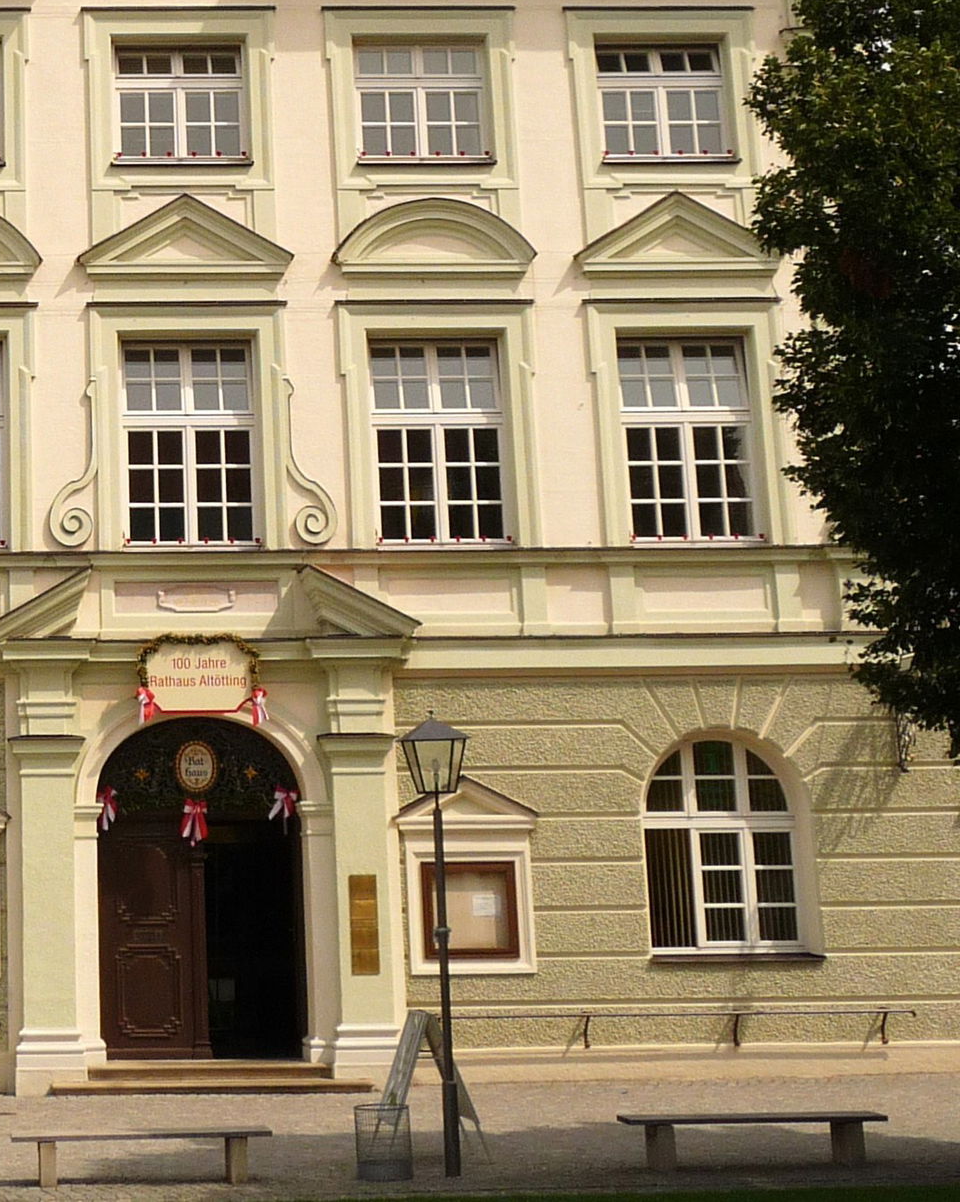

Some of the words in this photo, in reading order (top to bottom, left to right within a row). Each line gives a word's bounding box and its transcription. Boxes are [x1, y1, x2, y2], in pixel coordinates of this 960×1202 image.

[172, 657, 191, 670] 100
[195, 657, 227, 670] Jahre
[150, 675, 196, 687] Rathaus
[200, 674, 247, 689] Altötting
